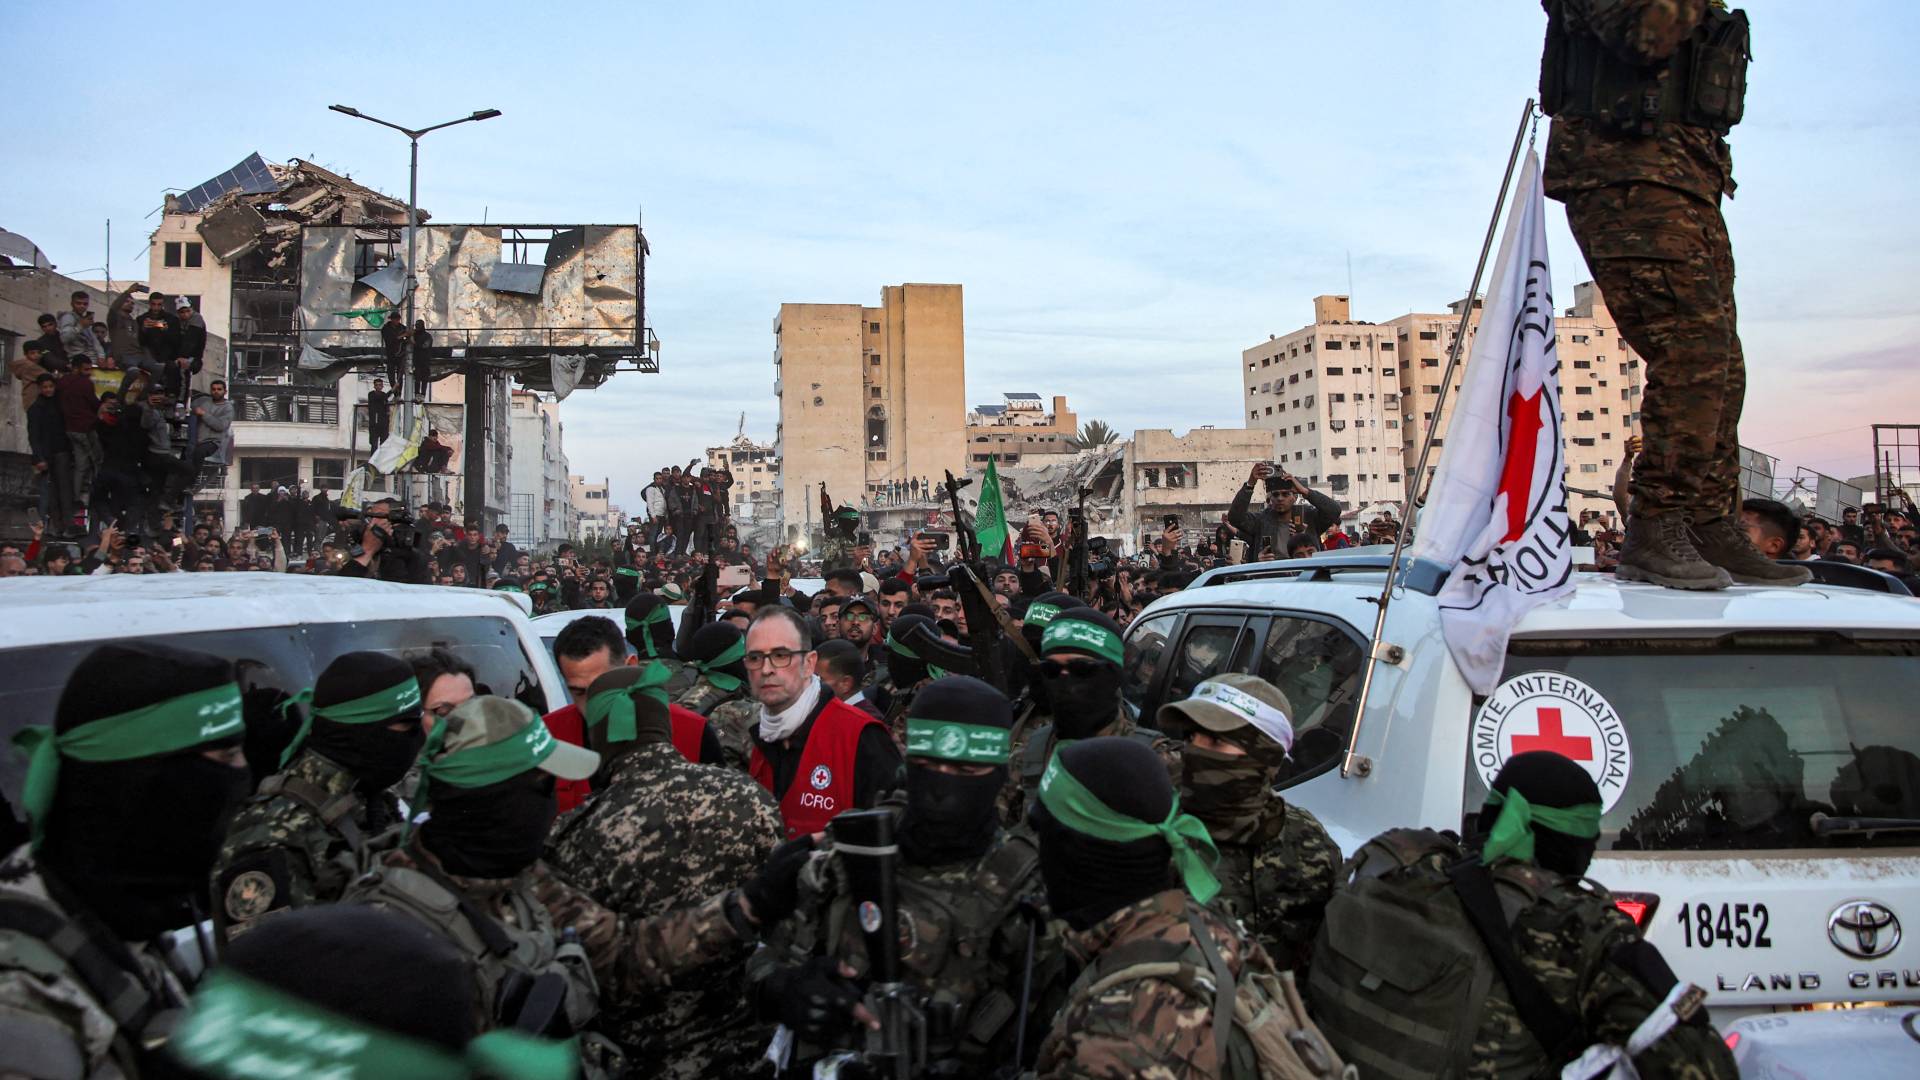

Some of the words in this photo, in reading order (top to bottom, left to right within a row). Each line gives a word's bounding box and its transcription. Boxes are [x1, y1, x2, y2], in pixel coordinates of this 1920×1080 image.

[1509, 676, 1626, 788] INTERNATIONAL
[800, 792, 834, 810] ICRC
[1678, 902, 1772, 948] 18452
[1716, 971, 1821, 992] LAND
